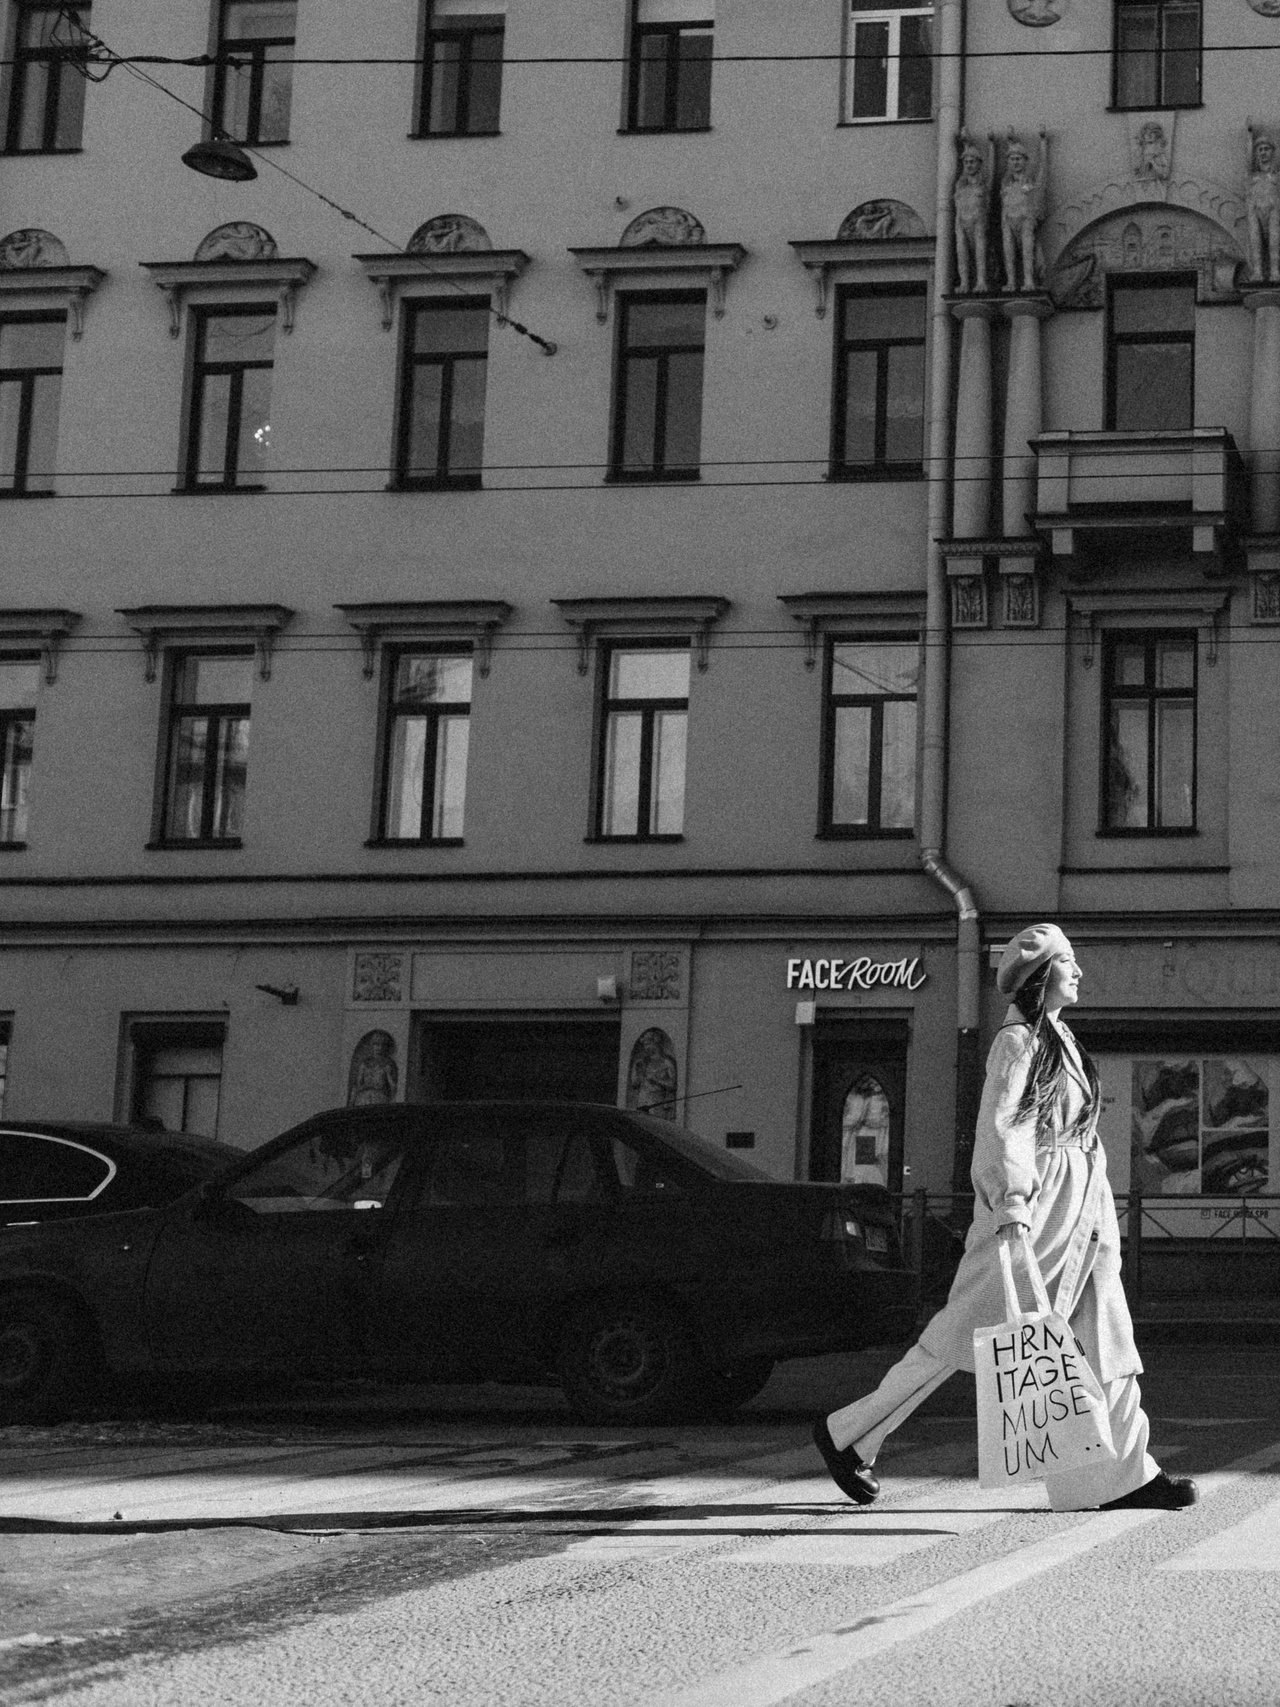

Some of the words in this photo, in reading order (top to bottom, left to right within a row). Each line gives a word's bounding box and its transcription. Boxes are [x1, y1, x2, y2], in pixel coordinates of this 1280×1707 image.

[787, 959, 844, 989] FACE
[996, 1353, 1081, 1403] ITAGE
[1003, 1385, 1091, 1441] MUSE
[1004, 1432, 1059, 1476] UM
